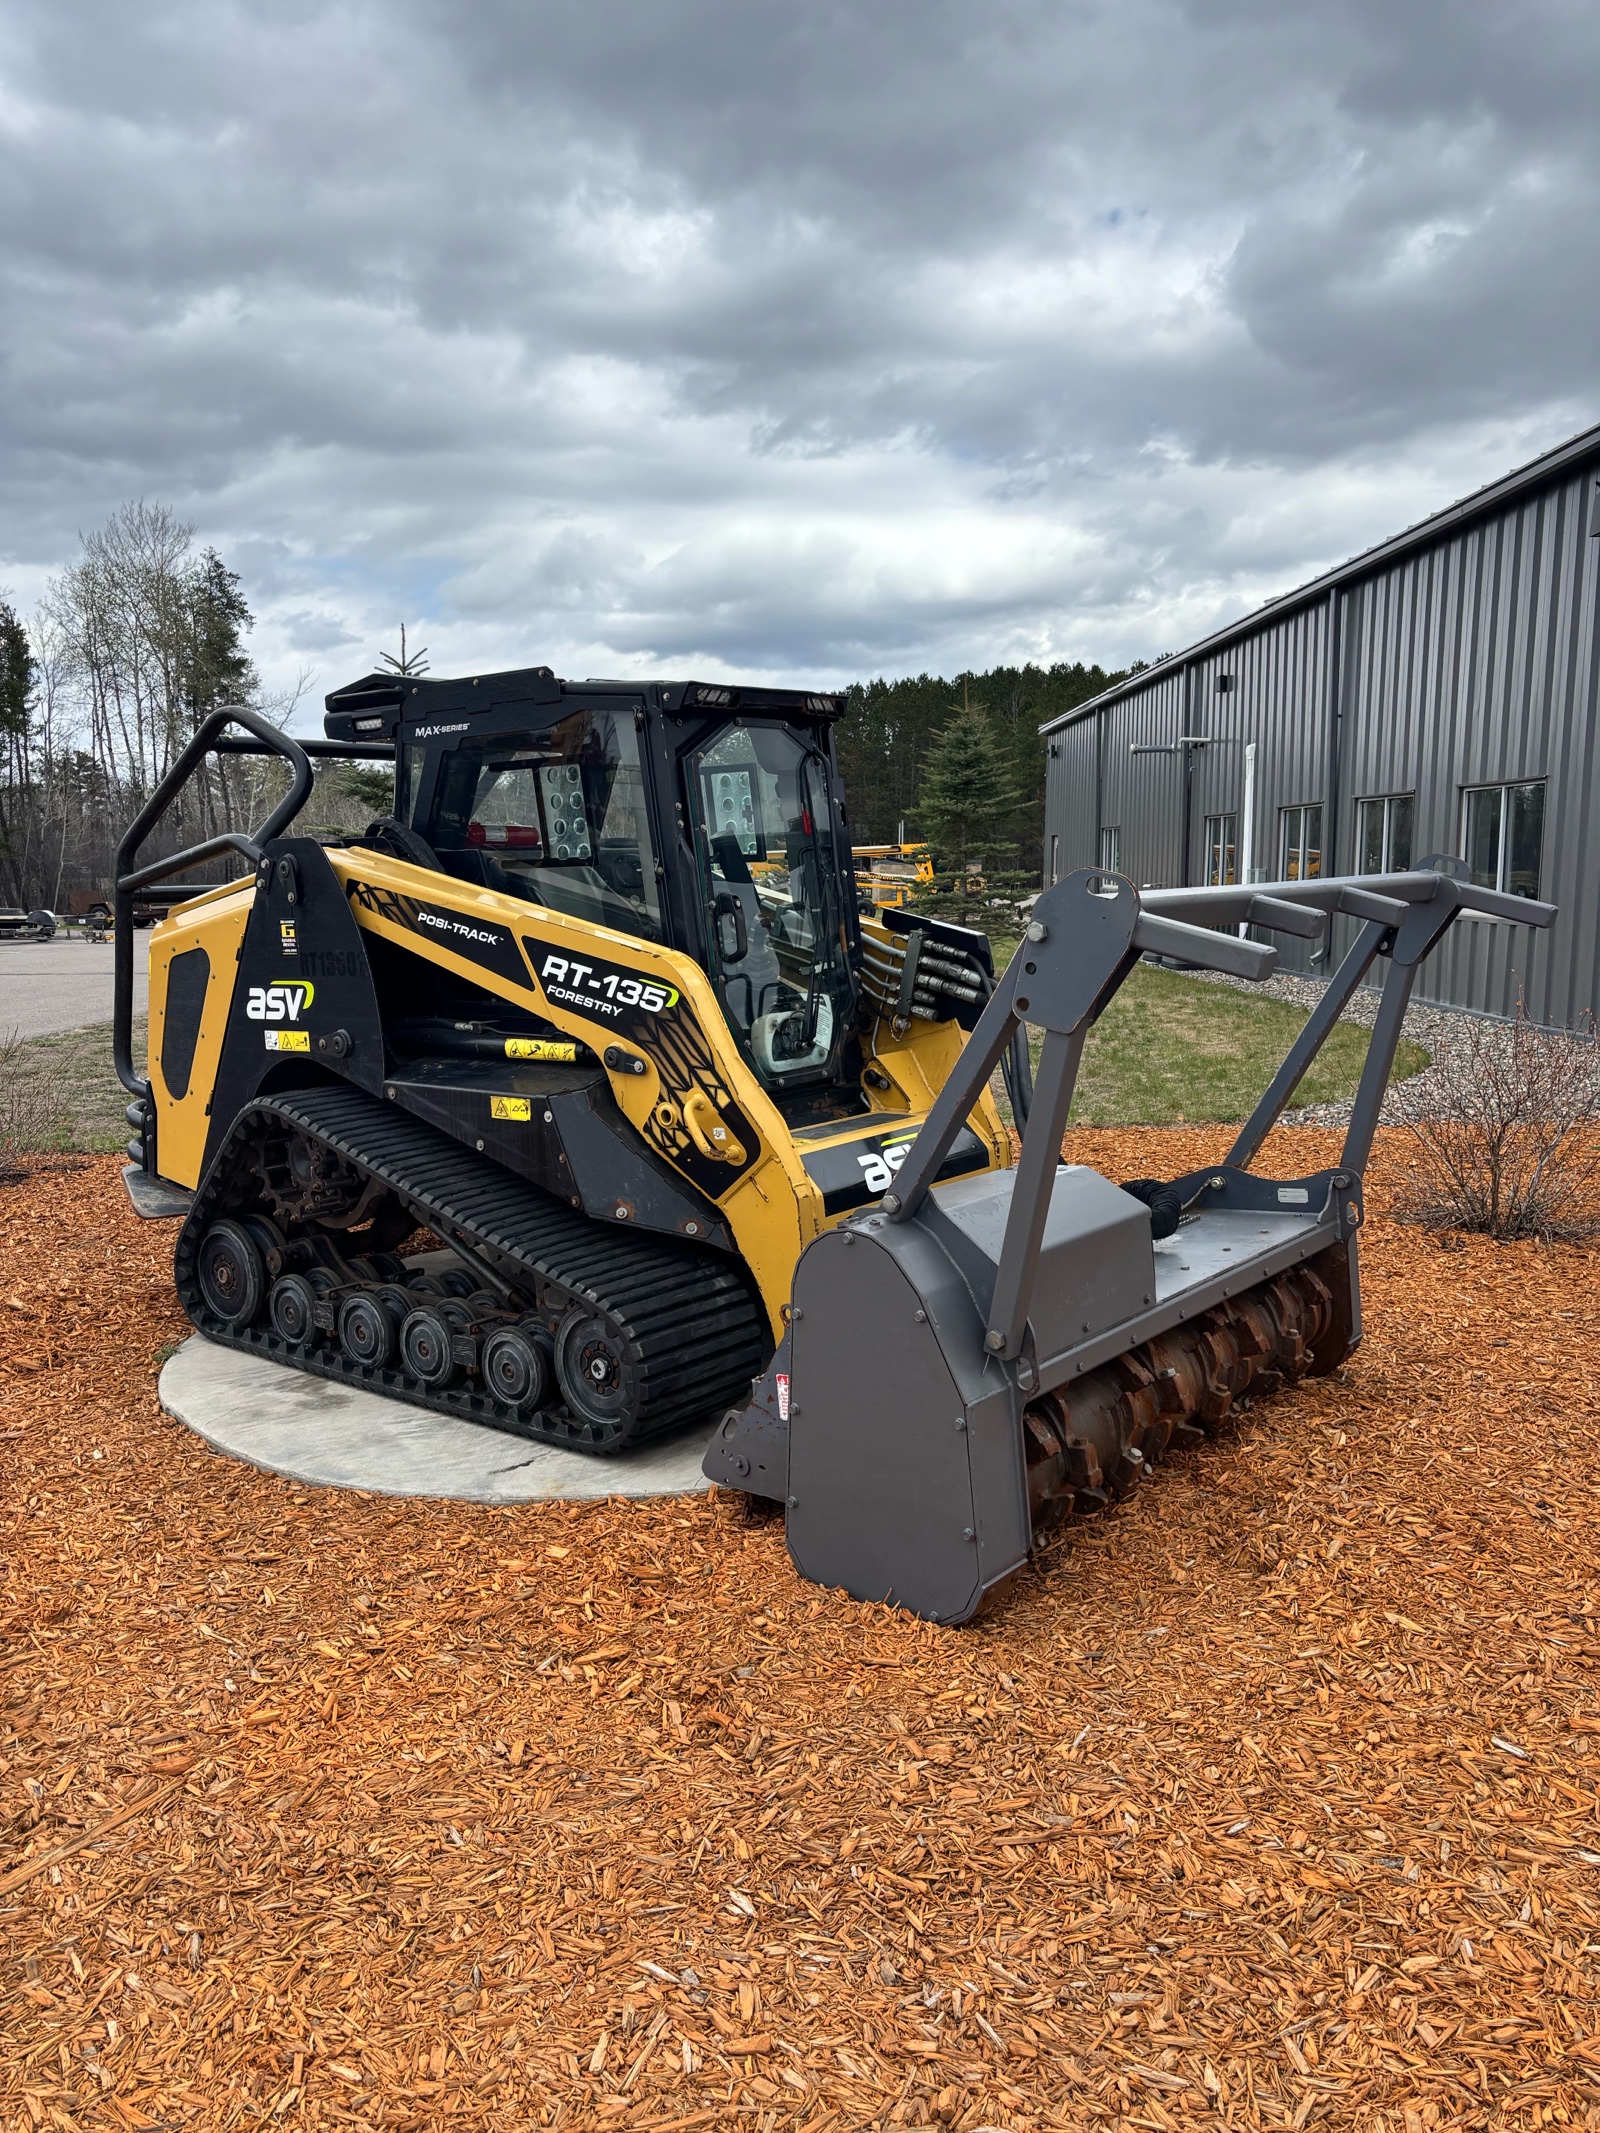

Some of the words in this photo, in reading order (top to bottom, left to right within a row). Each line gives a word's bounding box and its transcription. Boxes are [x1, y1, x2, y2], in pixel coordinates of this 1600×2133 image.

[415, 723, 470, 738] MAX-SERIES
[417, 912, 499, 946] POSI-TRACK
[541, 955, 667, 1013] RT-135
[546, 984, 624, 1017] FORESTRY
